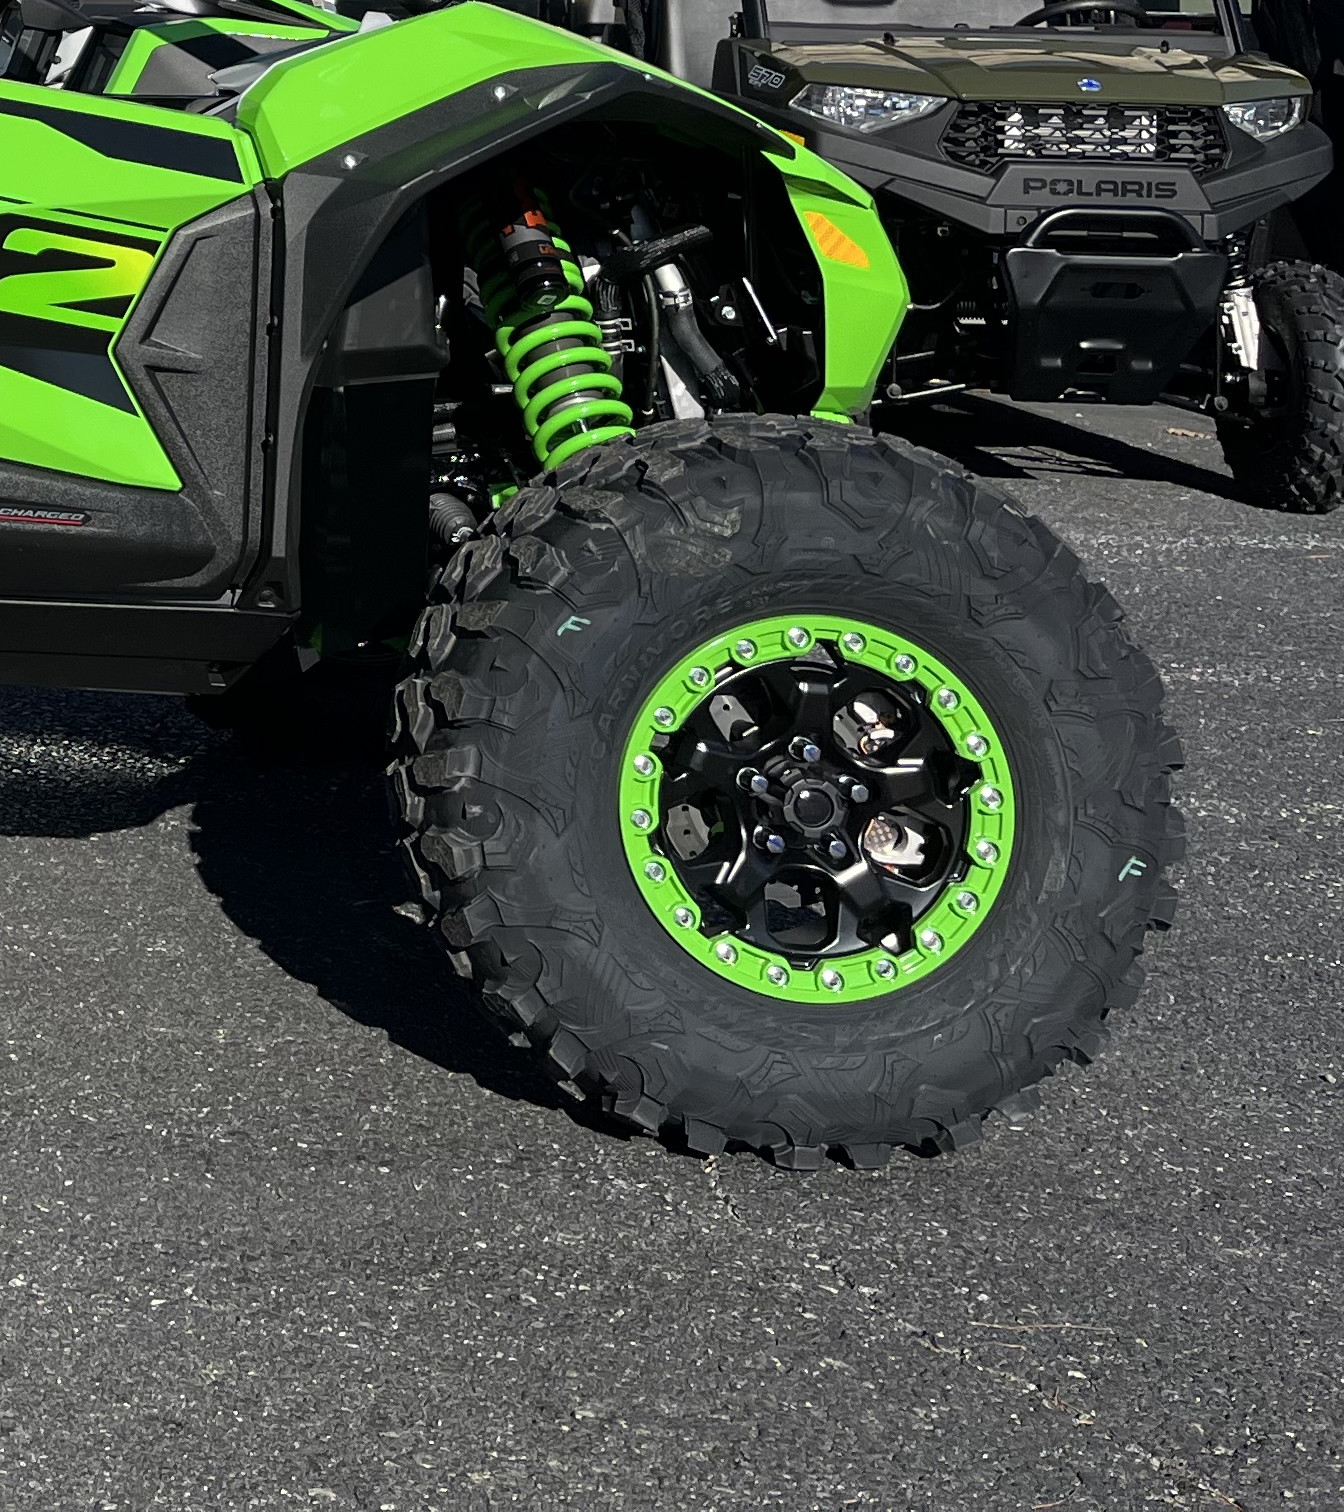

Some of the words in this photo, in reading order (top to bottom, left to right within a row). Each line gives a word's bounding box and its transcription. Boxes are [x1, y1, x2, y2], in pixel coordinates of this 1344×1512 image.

[748, 65, 786, 88] 570
[1023, 177, 1178, 199] POLARIS
[557, 616, 592, 636] F
[1118, 856, 1147, 881] F
